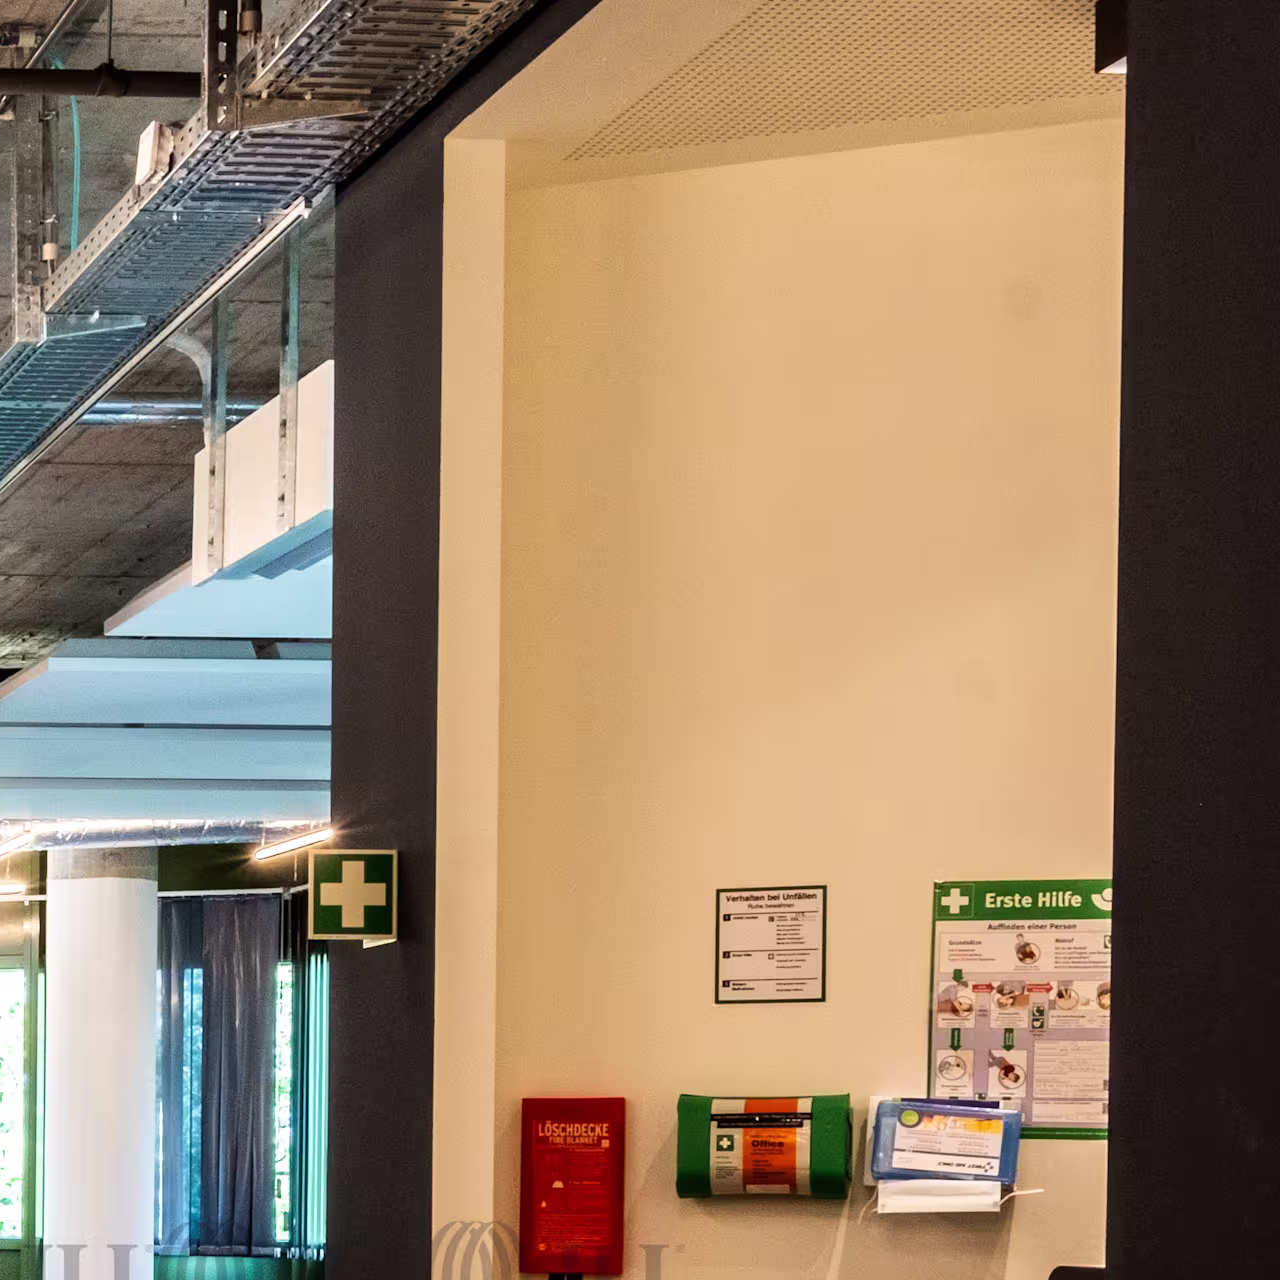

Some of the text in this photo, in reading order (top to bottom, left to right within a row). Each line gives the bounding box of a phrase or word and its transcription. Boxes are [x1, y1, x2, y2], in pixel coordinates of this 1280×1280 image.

[725, 892, 818, 903] Verhalten bei Unfällen
[985, 891, 1083, 908] Erste Hilfe
[987, 923, 1026, 931] Auffinden
[538, 1120, 609, 1137] LÖSCHDECKE
[549, 1136, 598, 1144] FIRE BLANKET
[751, 1139, 785, 1148] Office
